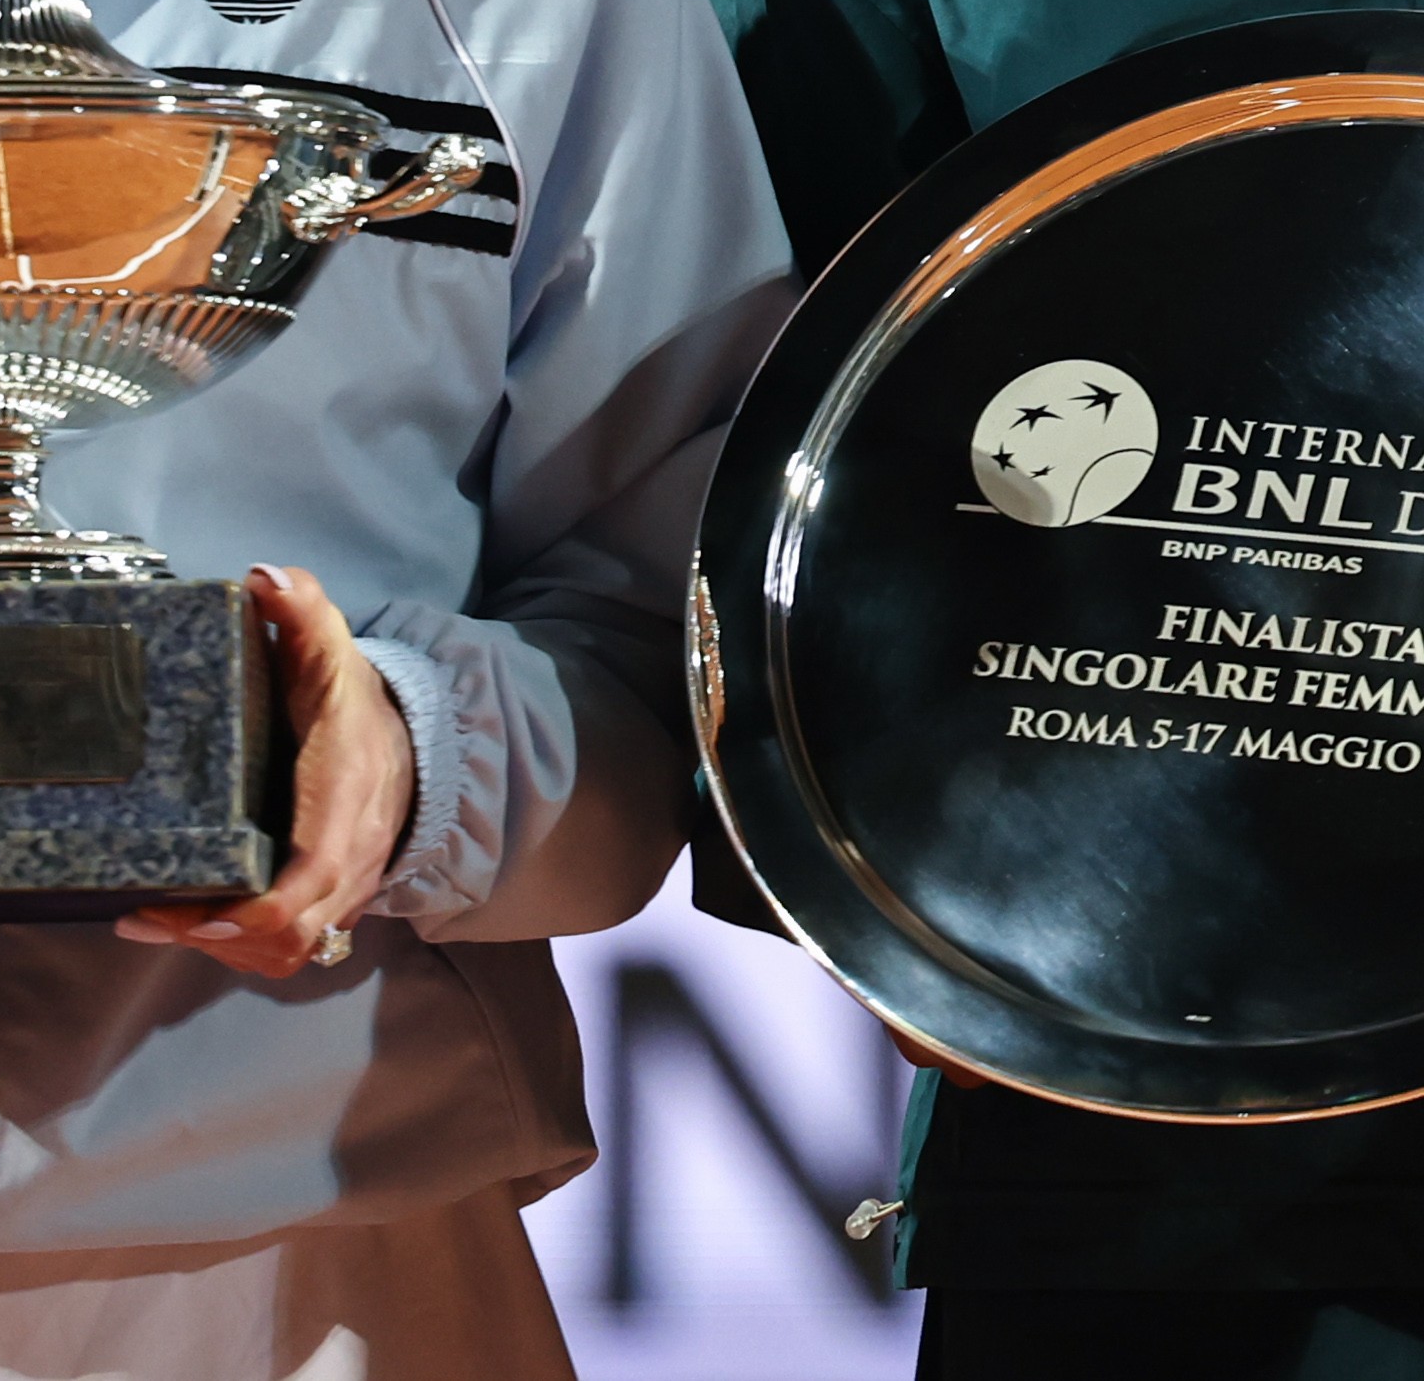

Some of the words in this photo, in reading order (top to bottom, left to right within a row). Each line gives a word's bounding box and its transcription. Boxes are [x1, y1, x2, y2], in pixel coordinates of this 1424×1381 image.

[1172, 463, 1374, 531] BNL
[1160, 539, 1229, 562] BNP
[1231, 545, 1364, 575] PARIBAS
[972, 642, 1278, 703] SINGOLARE
[1006, 706, 1140, 749] ROMA
[1146, 717, 1228, 754] 5-17
[1229, 725, 1422, 774] MAGGIO
